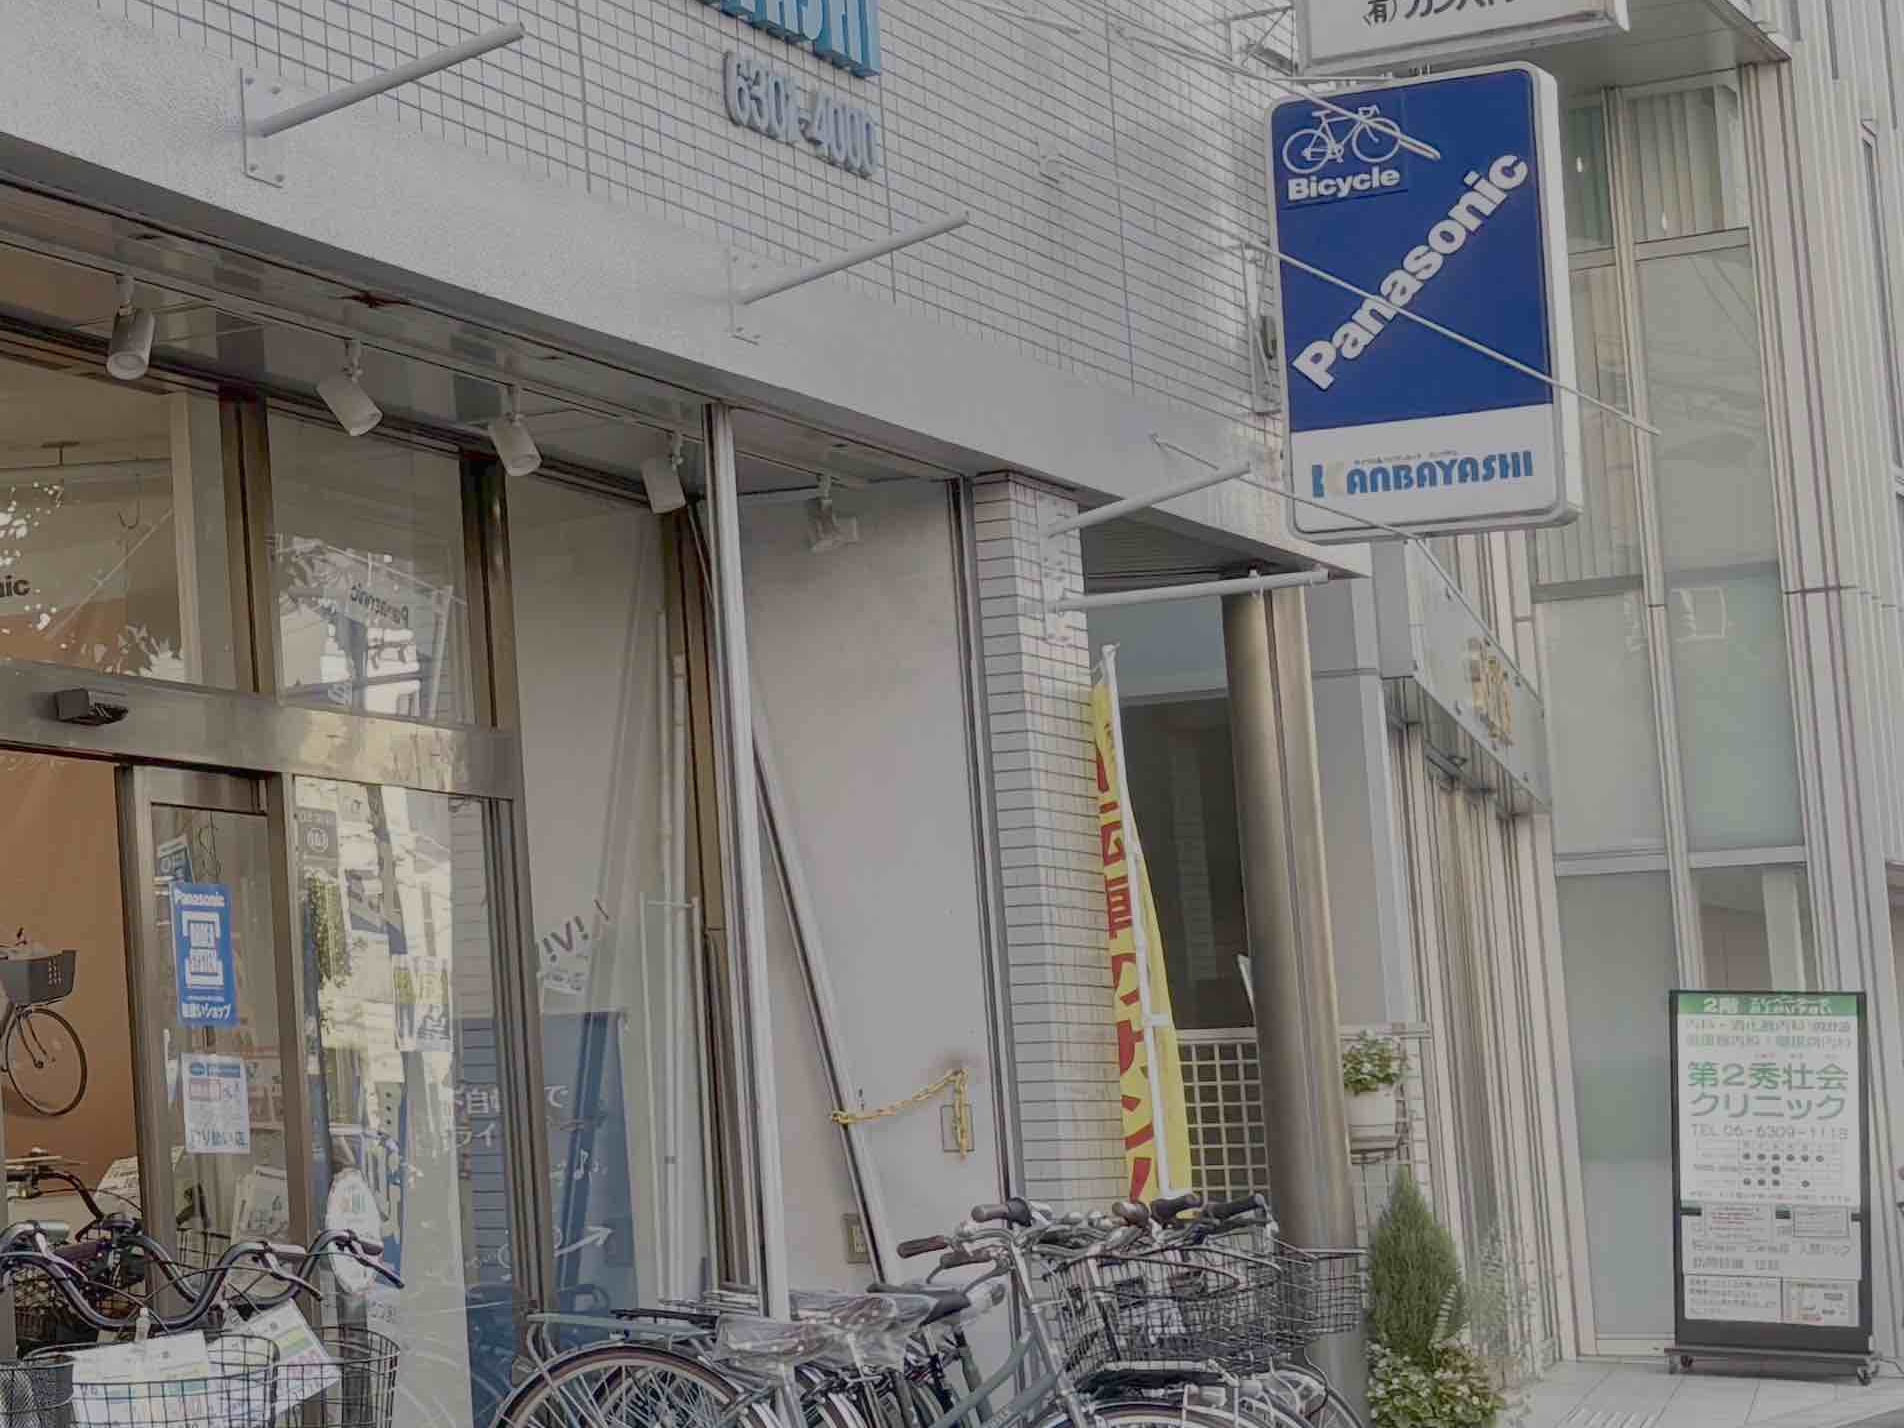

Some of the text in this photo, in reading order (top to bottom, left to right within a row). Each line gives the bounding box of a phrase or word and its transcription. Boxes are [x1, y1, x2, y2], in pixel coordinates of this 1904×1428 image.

[1286, 166, 1402, 202] Bicycle
[1292, 152, 1530, 391] Panasonic
[1691, 1091, 1846, 1121] クリニック
